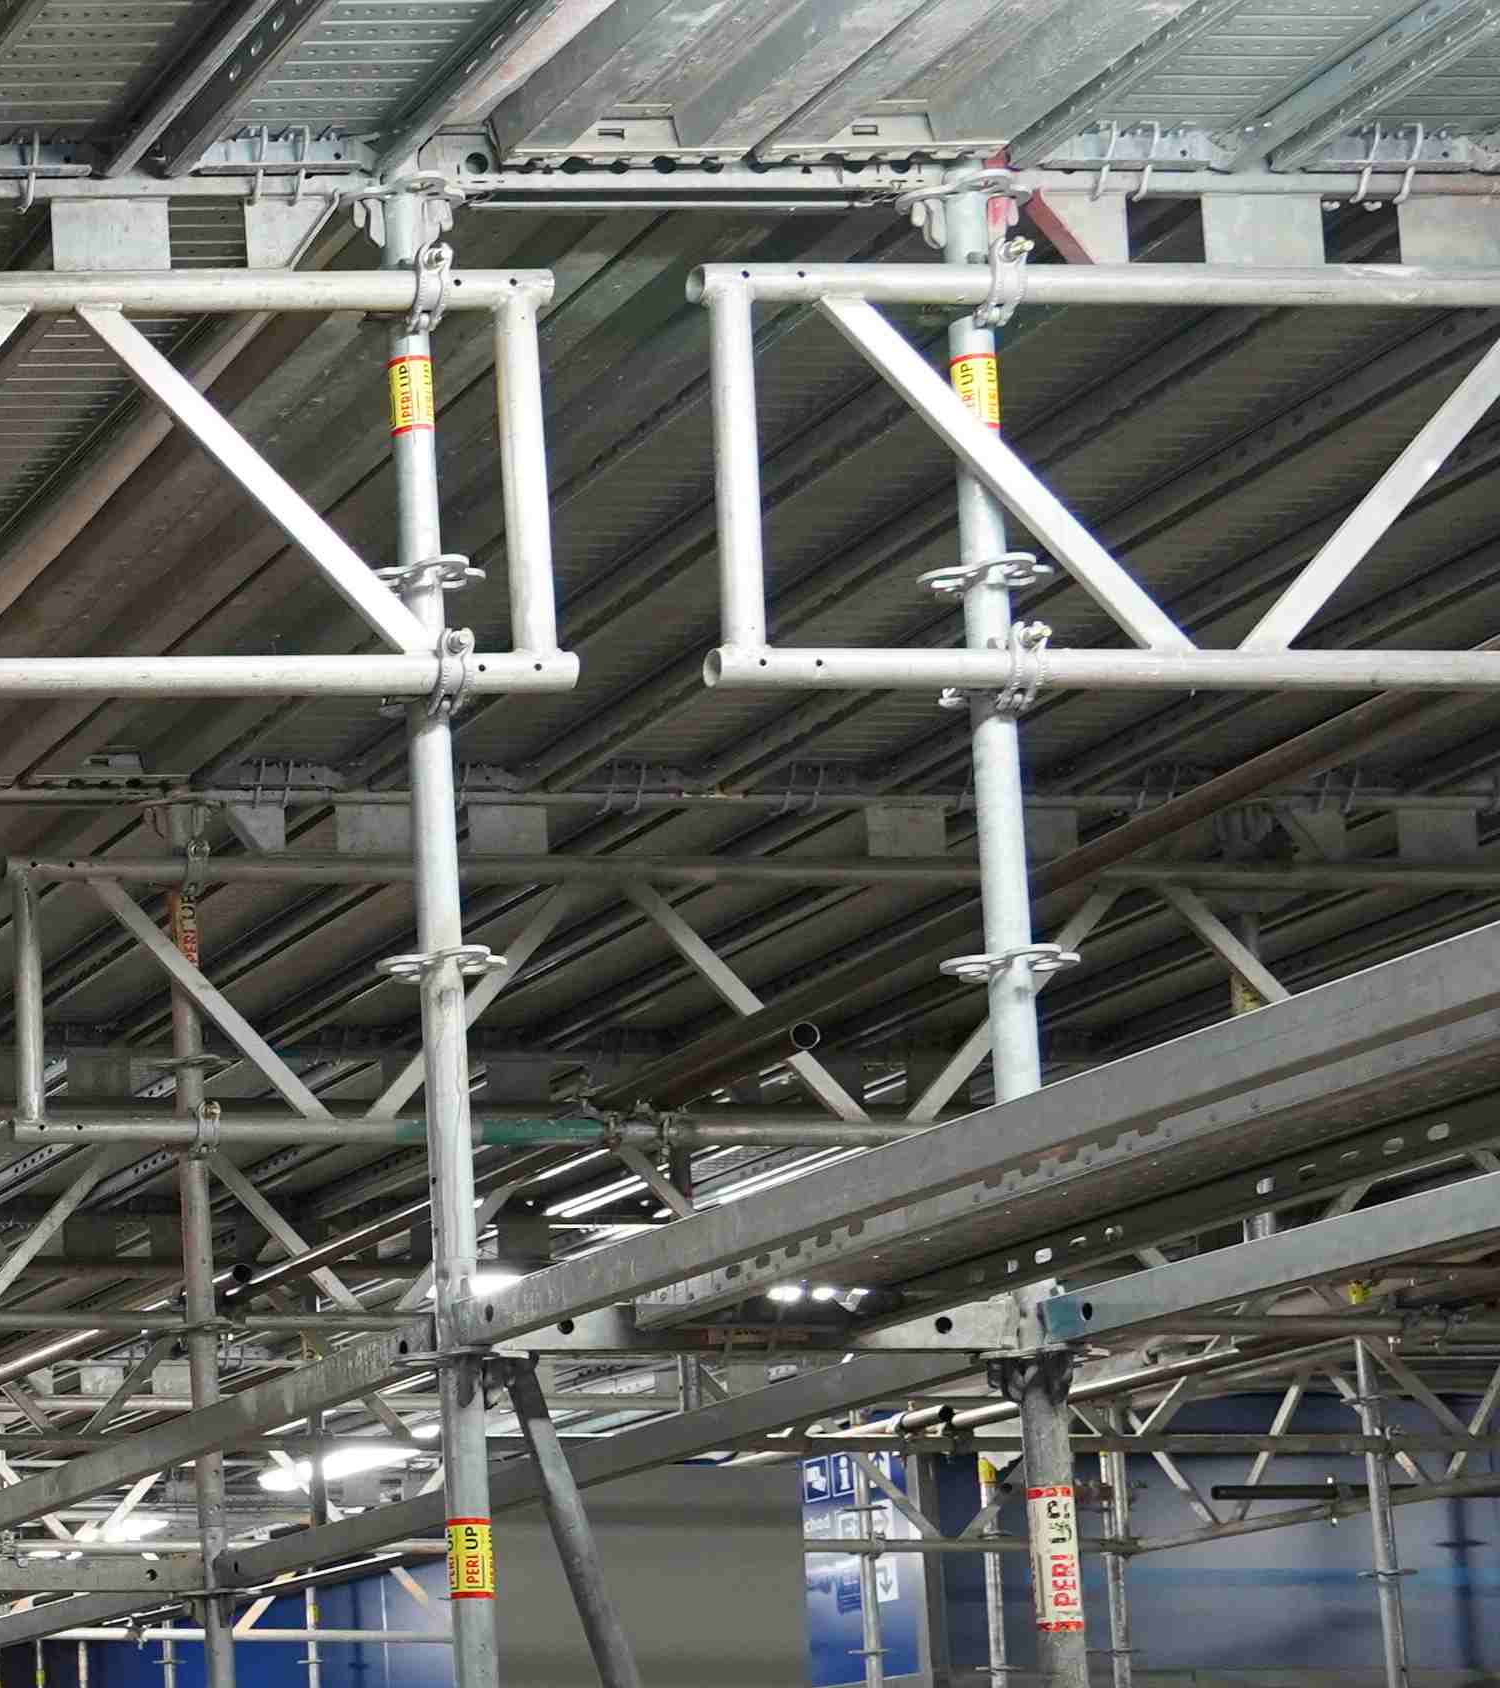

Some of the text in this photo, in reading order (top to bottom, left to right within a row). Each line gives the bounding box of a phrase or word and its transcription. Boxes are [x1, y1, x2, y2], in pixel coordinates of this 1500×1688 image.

[398, 365, 413, 418] PERI UP
[962, 363, 975, 384] UP
[464, 1527, 480, 1584] PERI UP
[1052, 1554, 1077, 1607] PERI
